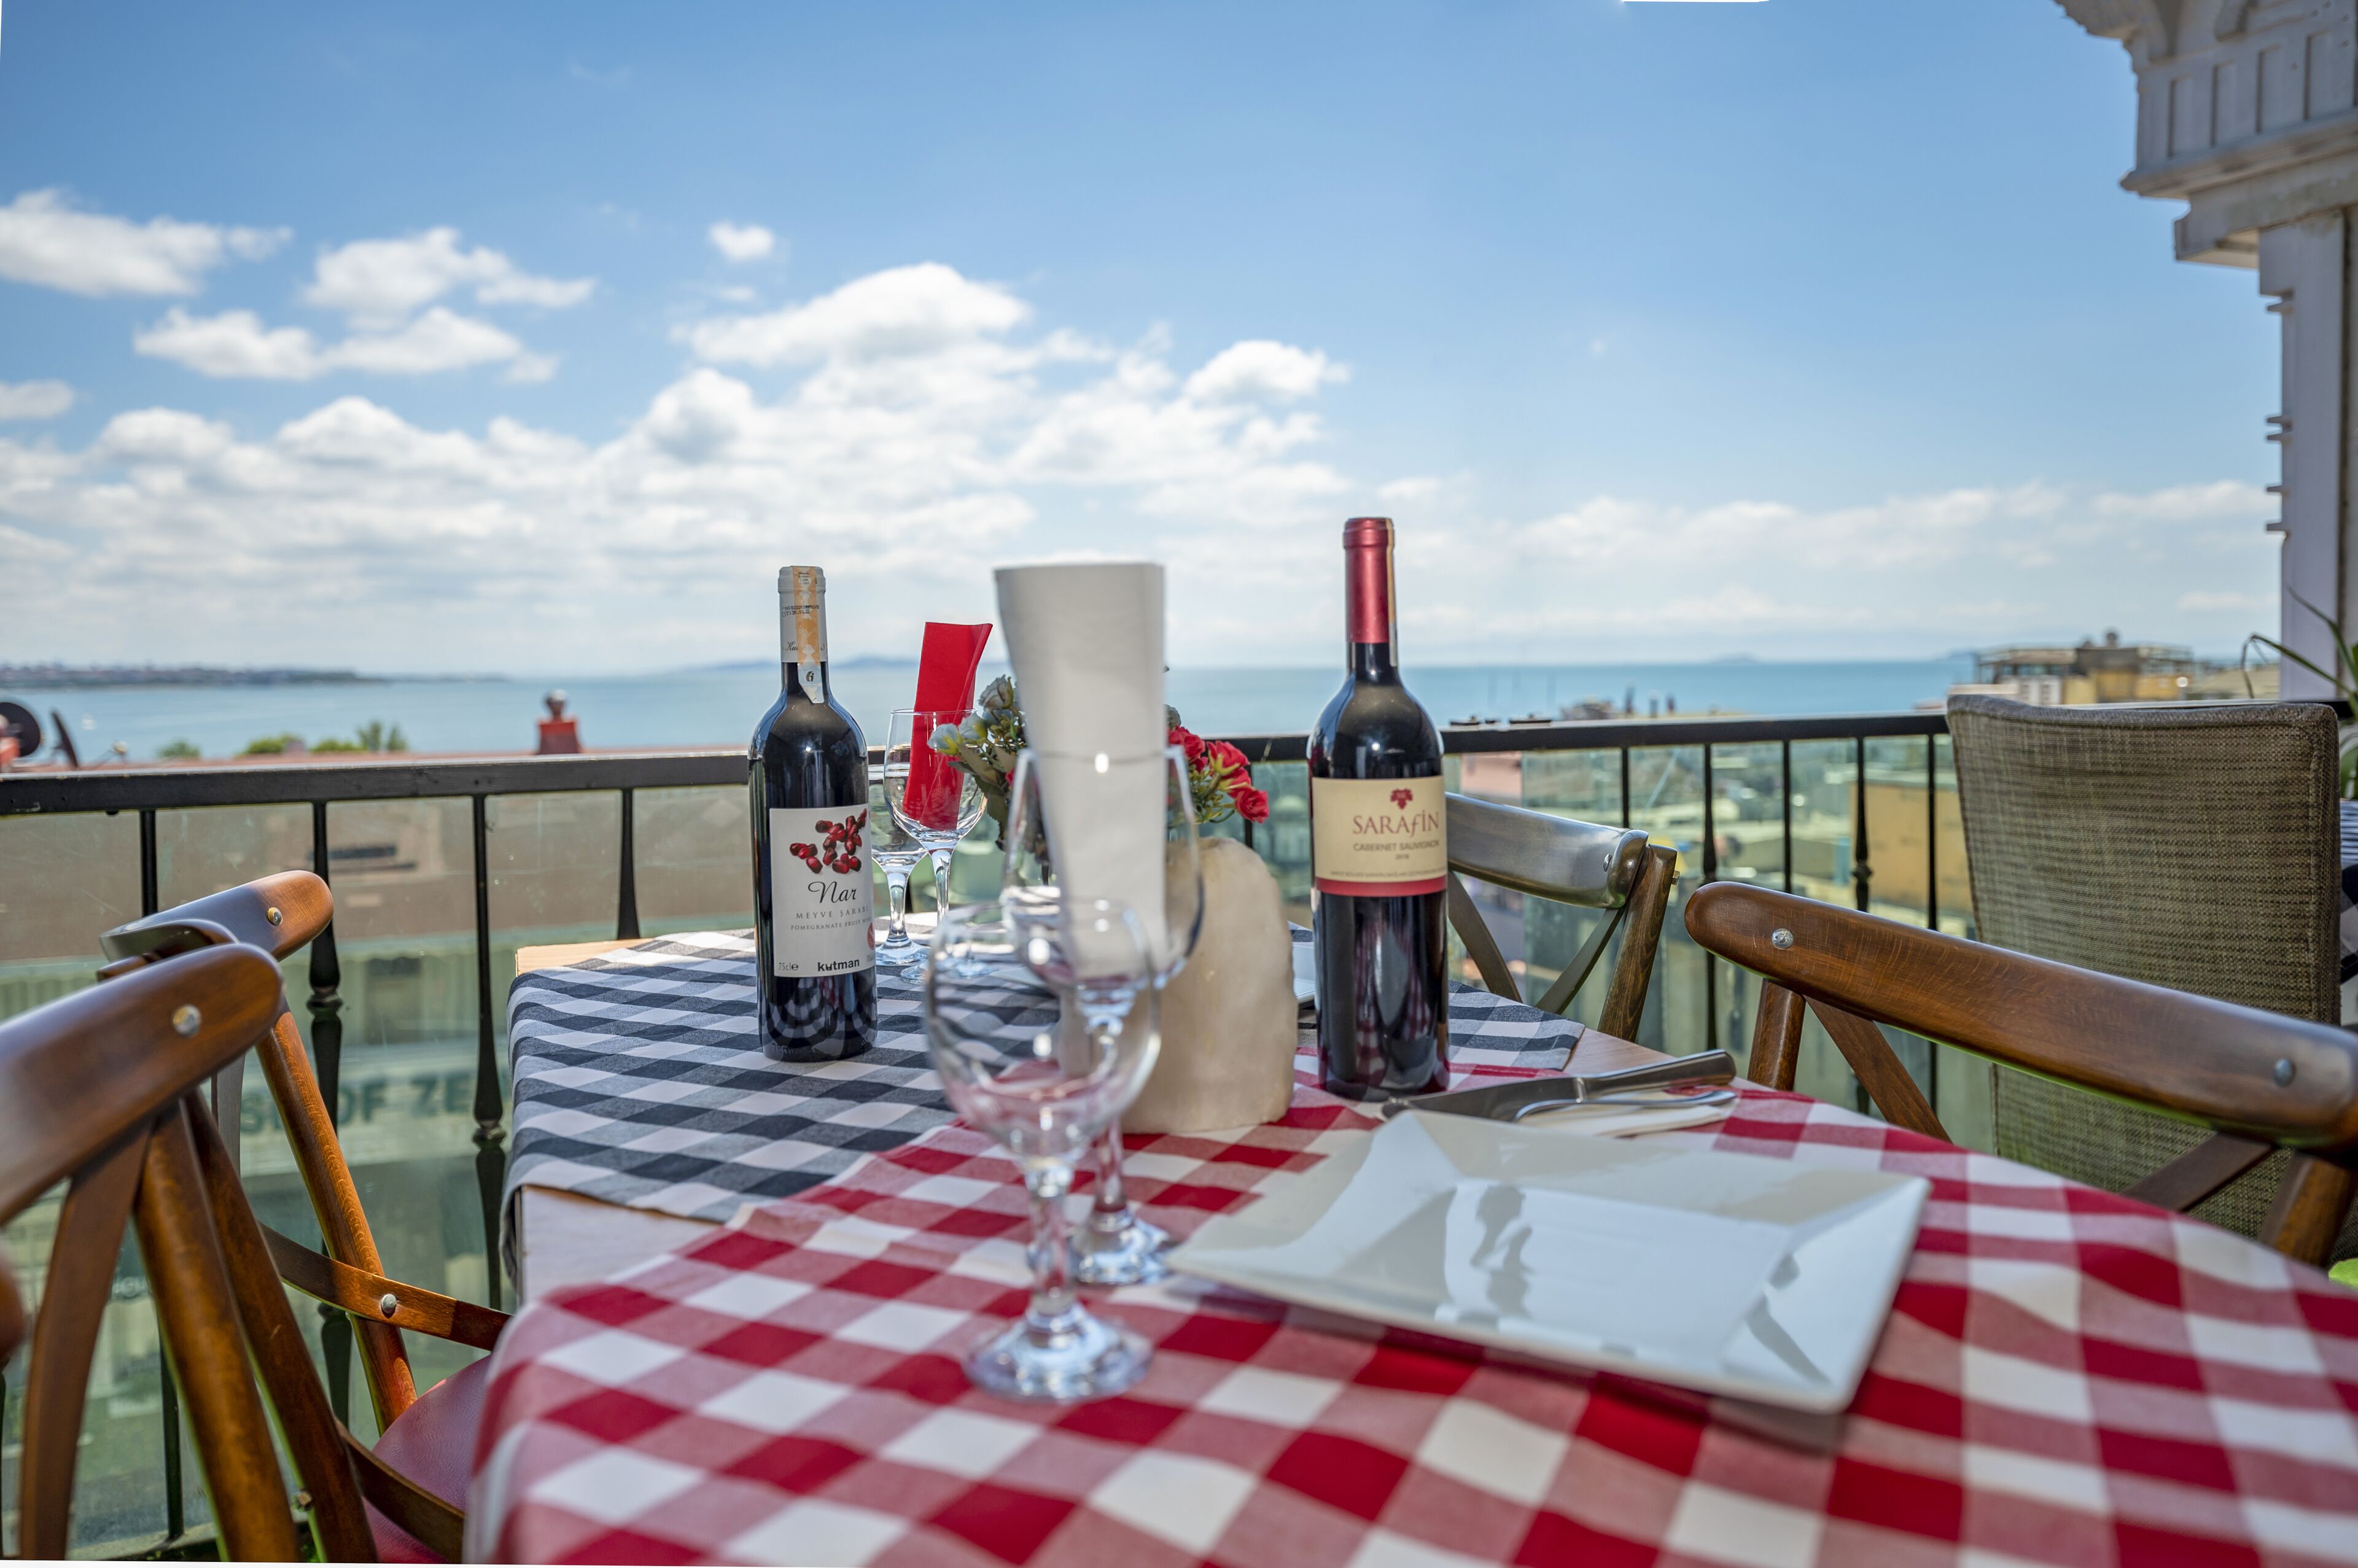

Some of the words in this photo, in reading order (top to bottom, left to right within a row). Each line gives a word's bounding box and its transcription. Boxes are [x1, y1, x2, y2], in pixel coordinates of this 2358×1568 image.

[1353, 842, 1397, 852] CABERNET
[807, 881, 857, 904] Nar
[839, 905, 869, 917] ŞARABI
[817, 959, 860, 971] kutman
